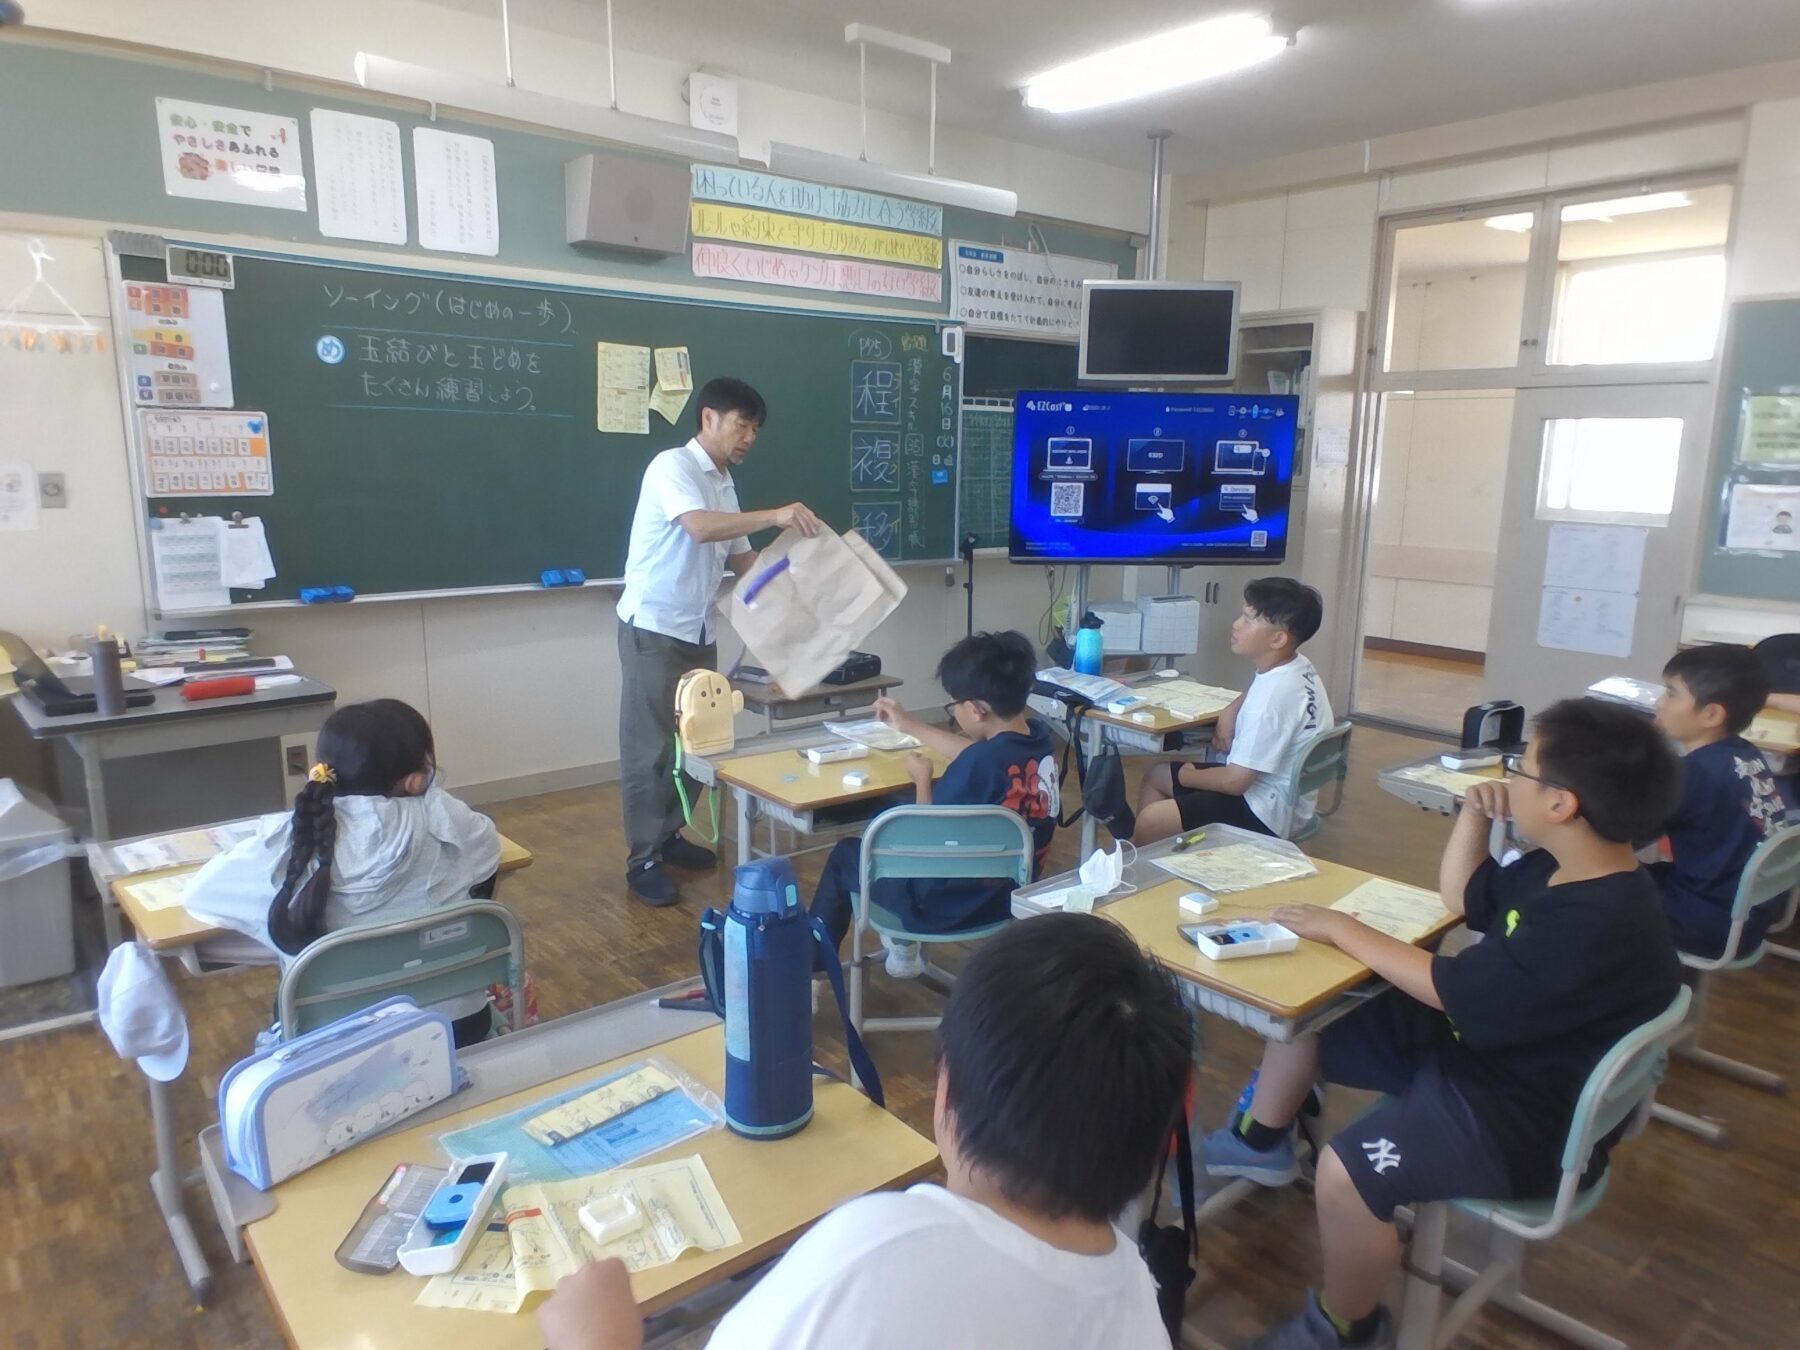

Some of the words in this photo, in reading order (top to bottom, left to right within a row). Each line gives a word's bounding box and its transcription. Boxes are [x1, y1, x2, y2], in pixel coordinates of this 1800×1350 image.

[173, 133, 280, 158] やさしさあふれる
[855, 370, 894, 416] 程
